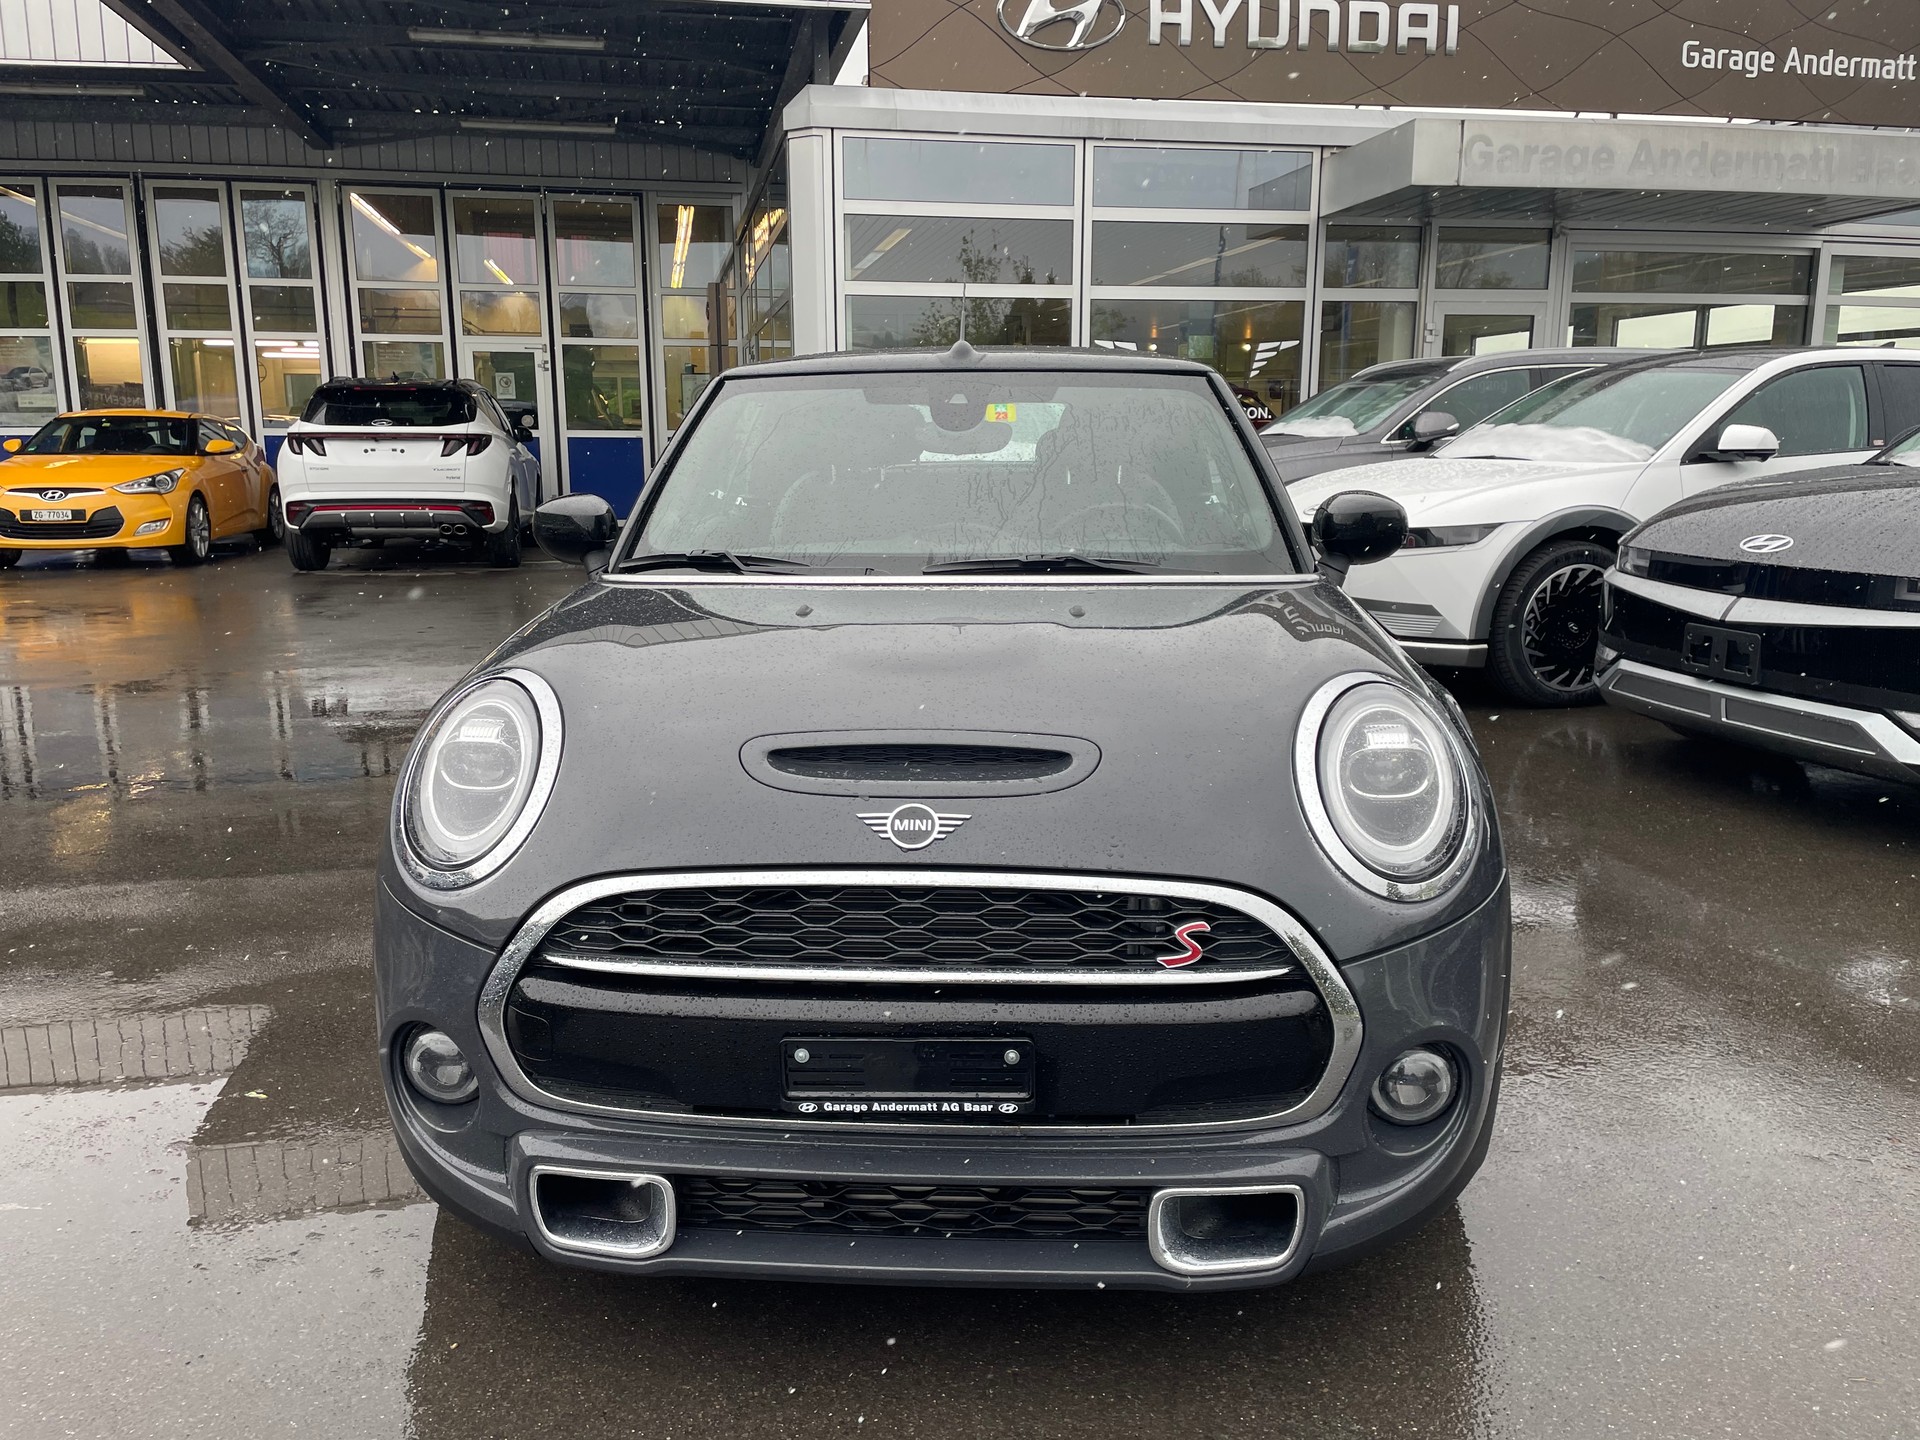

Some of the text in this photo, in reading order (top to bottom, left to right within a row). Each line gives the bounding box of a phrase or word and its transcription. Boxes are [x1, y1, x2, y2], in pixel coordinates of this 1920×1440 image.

[1148, 0, 1459, 56] HYUNDAI
[1681, 40, 1918, 81] Garage Andermatt
[1464, 132, 1616, 185] Garage
[1626, 138, 1836, 184] Andermatt
[995, 411, 1009, 421] 23
[1243, 406, 1272, 419] ON.
[34, 511, 70, 519] ZG 77034
[894, 819, 932, 831] MINI
[1156, 921, 1211, 969] S
[823, 1102, 994, 1113] Garage Andermatt AG Baar
